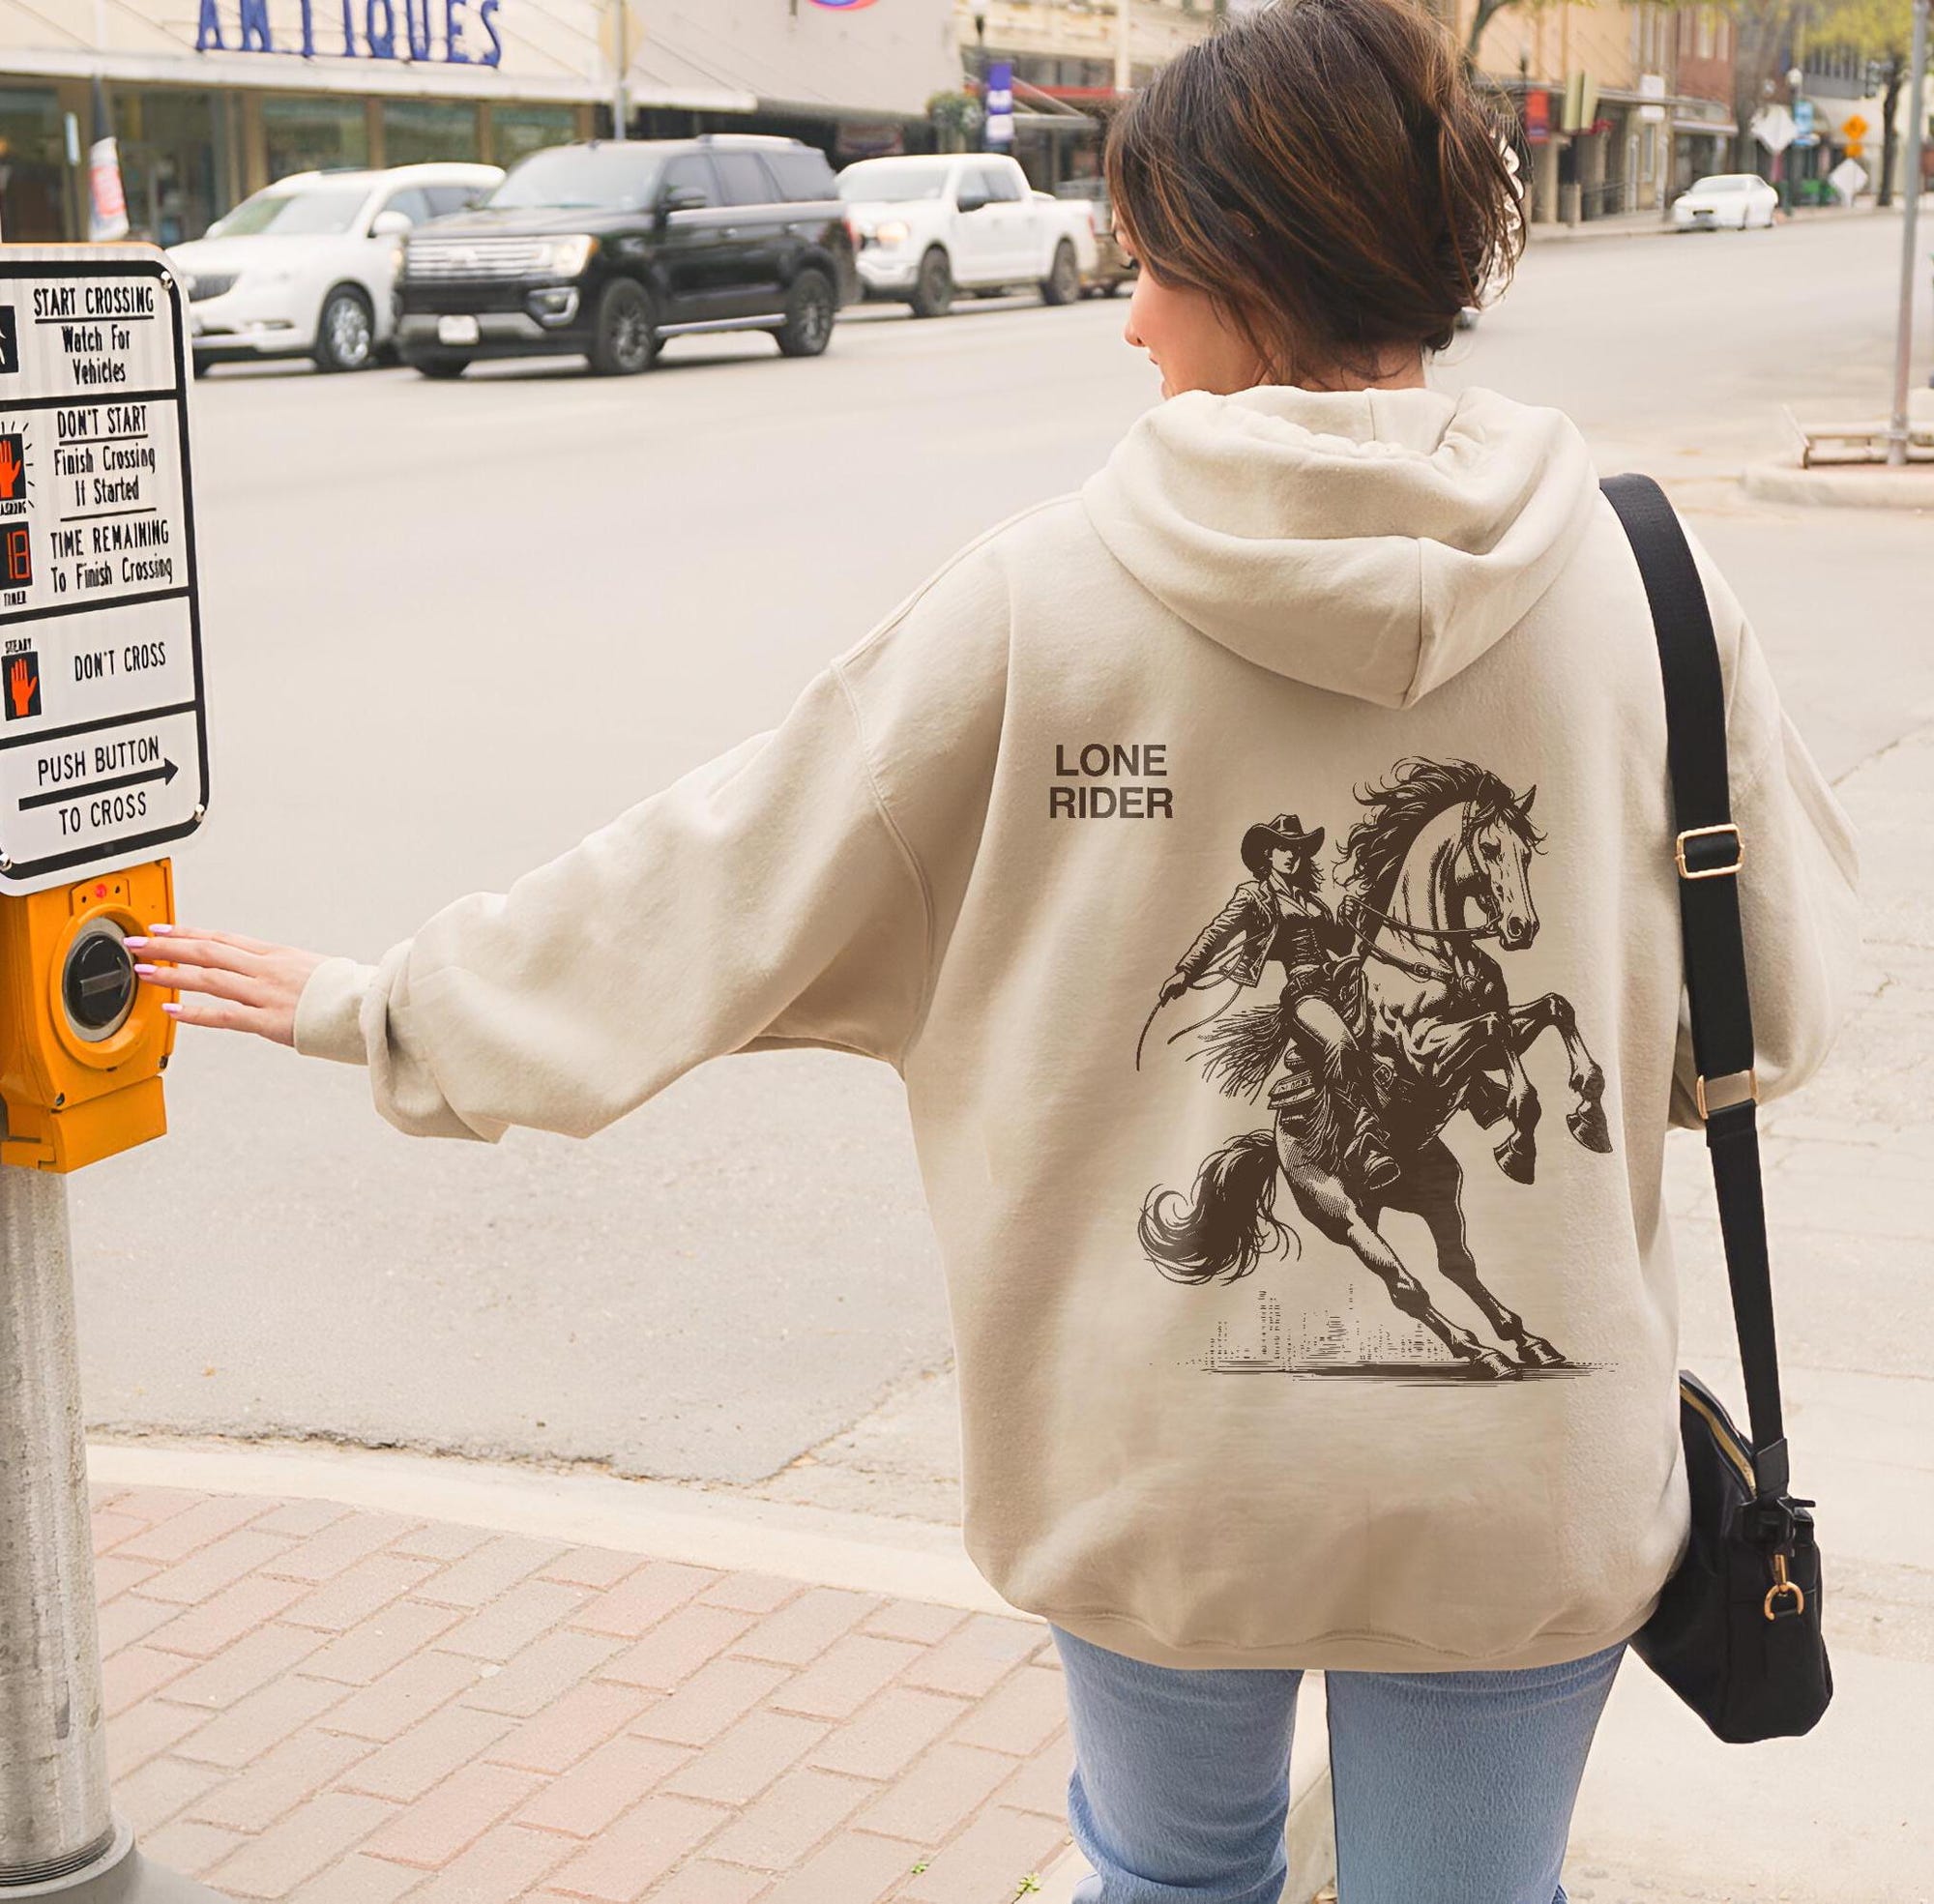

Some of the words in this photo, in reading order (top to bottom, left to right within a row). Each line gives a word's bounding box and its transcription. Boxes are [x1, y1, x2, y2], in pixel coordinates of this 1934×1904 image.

[34, 288, 76, 316] START
[85, 286, 155, 313] CROSSING
[61, 325, 103, 353] Watch
[111, 323, 131, 350] For
[73, 357, 126, 385] Vehicles
[57, 408, 99, 438] DON'T
[108, 405, 147, 433] START
[54, 448, 95, 476] Finish
[103, 443, 156, 474] Crossing
[75, 480, 86, 507] If
[94, 475, 139, 505] Started
[50, 529, 85, 560] TIME
[93, 519, 169, 553] REMAINING
[50, 567, 67, 593] To
[76, 561, 113, 590] Finish
[122, 552, 173, 584] Crossing
[5, 637, 32, 654] STEADY
[74, 649, 115, 682] DON'T
[124, 642, 166, 672] CROSS
[38, 750, 86, 786] PUSH
[95, 735, 160, 773] BUTTON
[1056, 744, 1167, 776] LONE
[59, 806, 81, 835] TO
[90, 791, 147, 828] CROSS
[1050, 786, 1173, 818] RIDER
